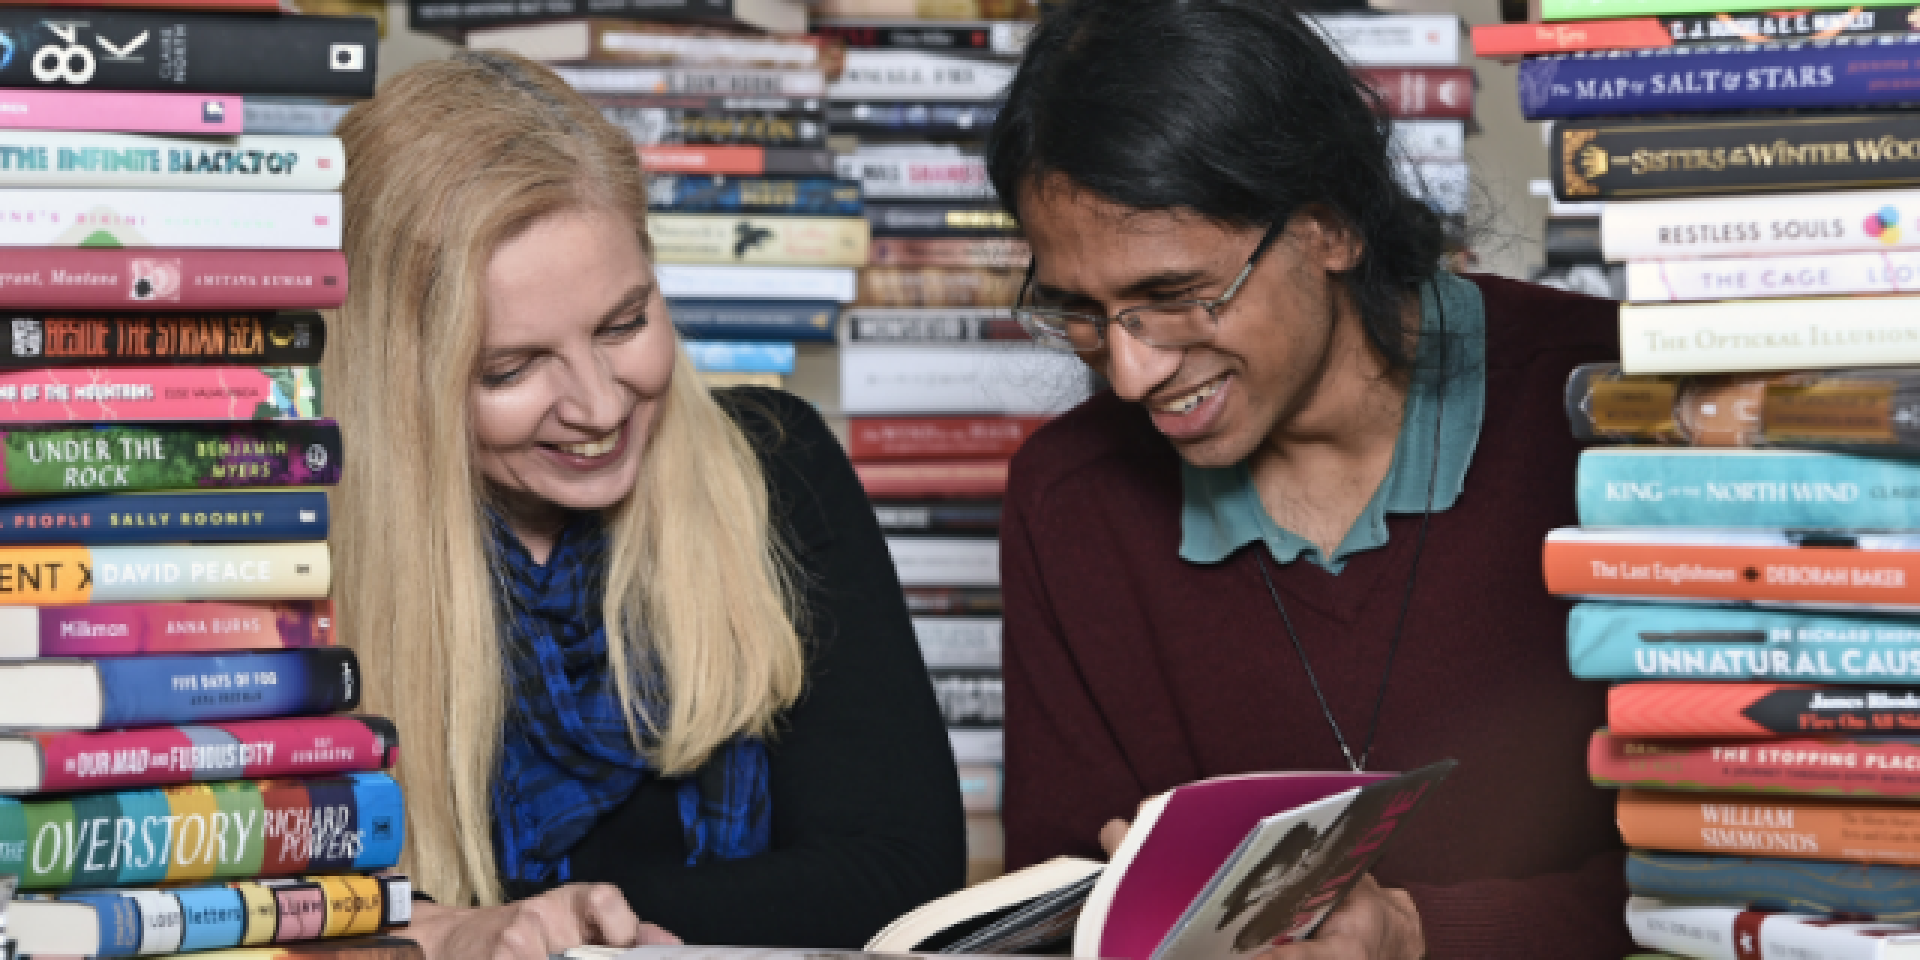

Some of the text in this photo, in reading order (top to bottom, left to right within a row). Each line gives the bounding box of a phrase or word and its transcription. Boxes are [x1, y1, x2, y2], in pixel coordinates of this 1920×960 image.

[1576, 81, 1626, 101] MAP
[1652, 72, 1716, 94] SALT
[1720, 71, 1740, 92] &
[1745, 65, 1835, 90] STARS
[0, 147, 298, 175] THE INFINITE BLACKTOP
[1632, 149, 1725, 176] SISTERS
[1748, 136, 1851, 169] WINTER
[1659, 218, 1845, 245] RESTLESS SOULS
[51, 270, 118, 286] Montana
[264, 275, 313, 286] KUMAR
[1702, 268, 1831, 290] THE CAGE
[45, 318, 111, 356] BESIDE
[116, 318, 152, 356] THE
[156, 318, 225, 356] SYRIAN
[228, 318, 265, 356] SEA
[45, 384, 71, 401] THE
[75, 384, 155, 402] MOUNTAINS
[28, 437, 166, 463] UNDER THE
[196, 440, 288, 457] BENJAMIN
[63, 465, 130, 488] ROCK
[212, 462, 272, 479] MYERS
[1605, 482, 1663, 503] KING
[1706, 482, 1788, 503] NORTH
[1792, 482, 1860, 503] WIND
[14, 512, 92, 529] PEOPLE
[110, 511, 265, 527] SALLY ROONEY
[101, 560, 272, 586] DAVID PEACE
[1590, 560, 1737, 585] The Last Englishmen
[1766, 565, 1905, 588] DEBORAH BAKER
[60, 620, 129, 638] Milkman
[165, 617, 262, 635] ANNA BURNS
[1797, 628, 1871, 644] RICHARD
[1635, 649, 1836, 676] UNNATURAL
[78, 751, 112, 778] OUR
[112, 747, 148, 775] MAD
[170, 743, 236, 773] FURIOUS
[239, 740, 275, 766] CITY
[1711, 747, 1751, 764] THE
[1757, 749, 1857, 769] STOPPING
[262, 804, 351, 840] RICHARD
[1701, 803, 1795, 830] WILLIAM
[0, 809, 258, 876] THE OVERSTORY
[279, 830, 366, 864] POWERS
[1701, 829, 1819, 853] SIMMONDS
[187, 906, 242, 926] letters
[331, 892, 380, 913] WOOLF
